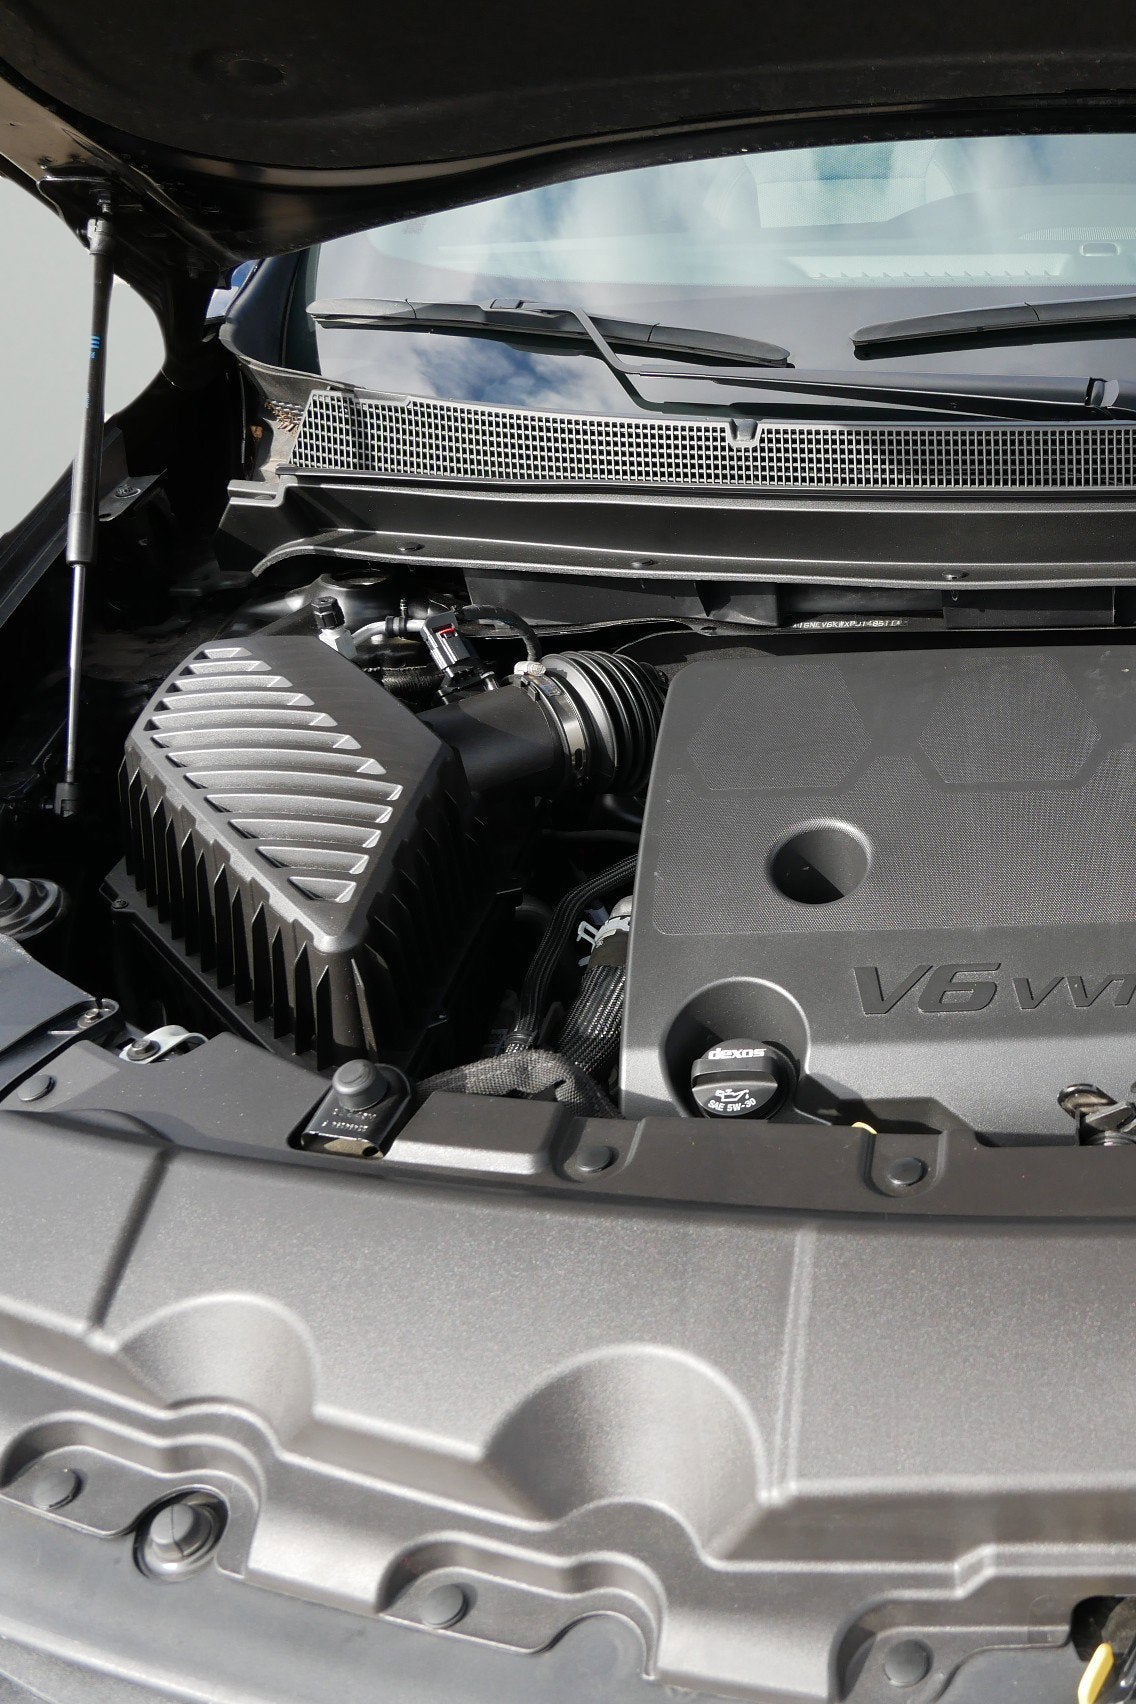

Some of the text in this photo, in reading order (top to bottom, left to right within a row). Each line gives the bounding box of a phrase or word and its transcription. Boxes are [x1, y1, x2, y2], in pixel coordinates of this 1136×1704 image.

[852, 962, 1001, 1015] V6
[708, 1047, 766, 1059] dexos
[708, 1098, 756, 1112] SAE 5W-30
